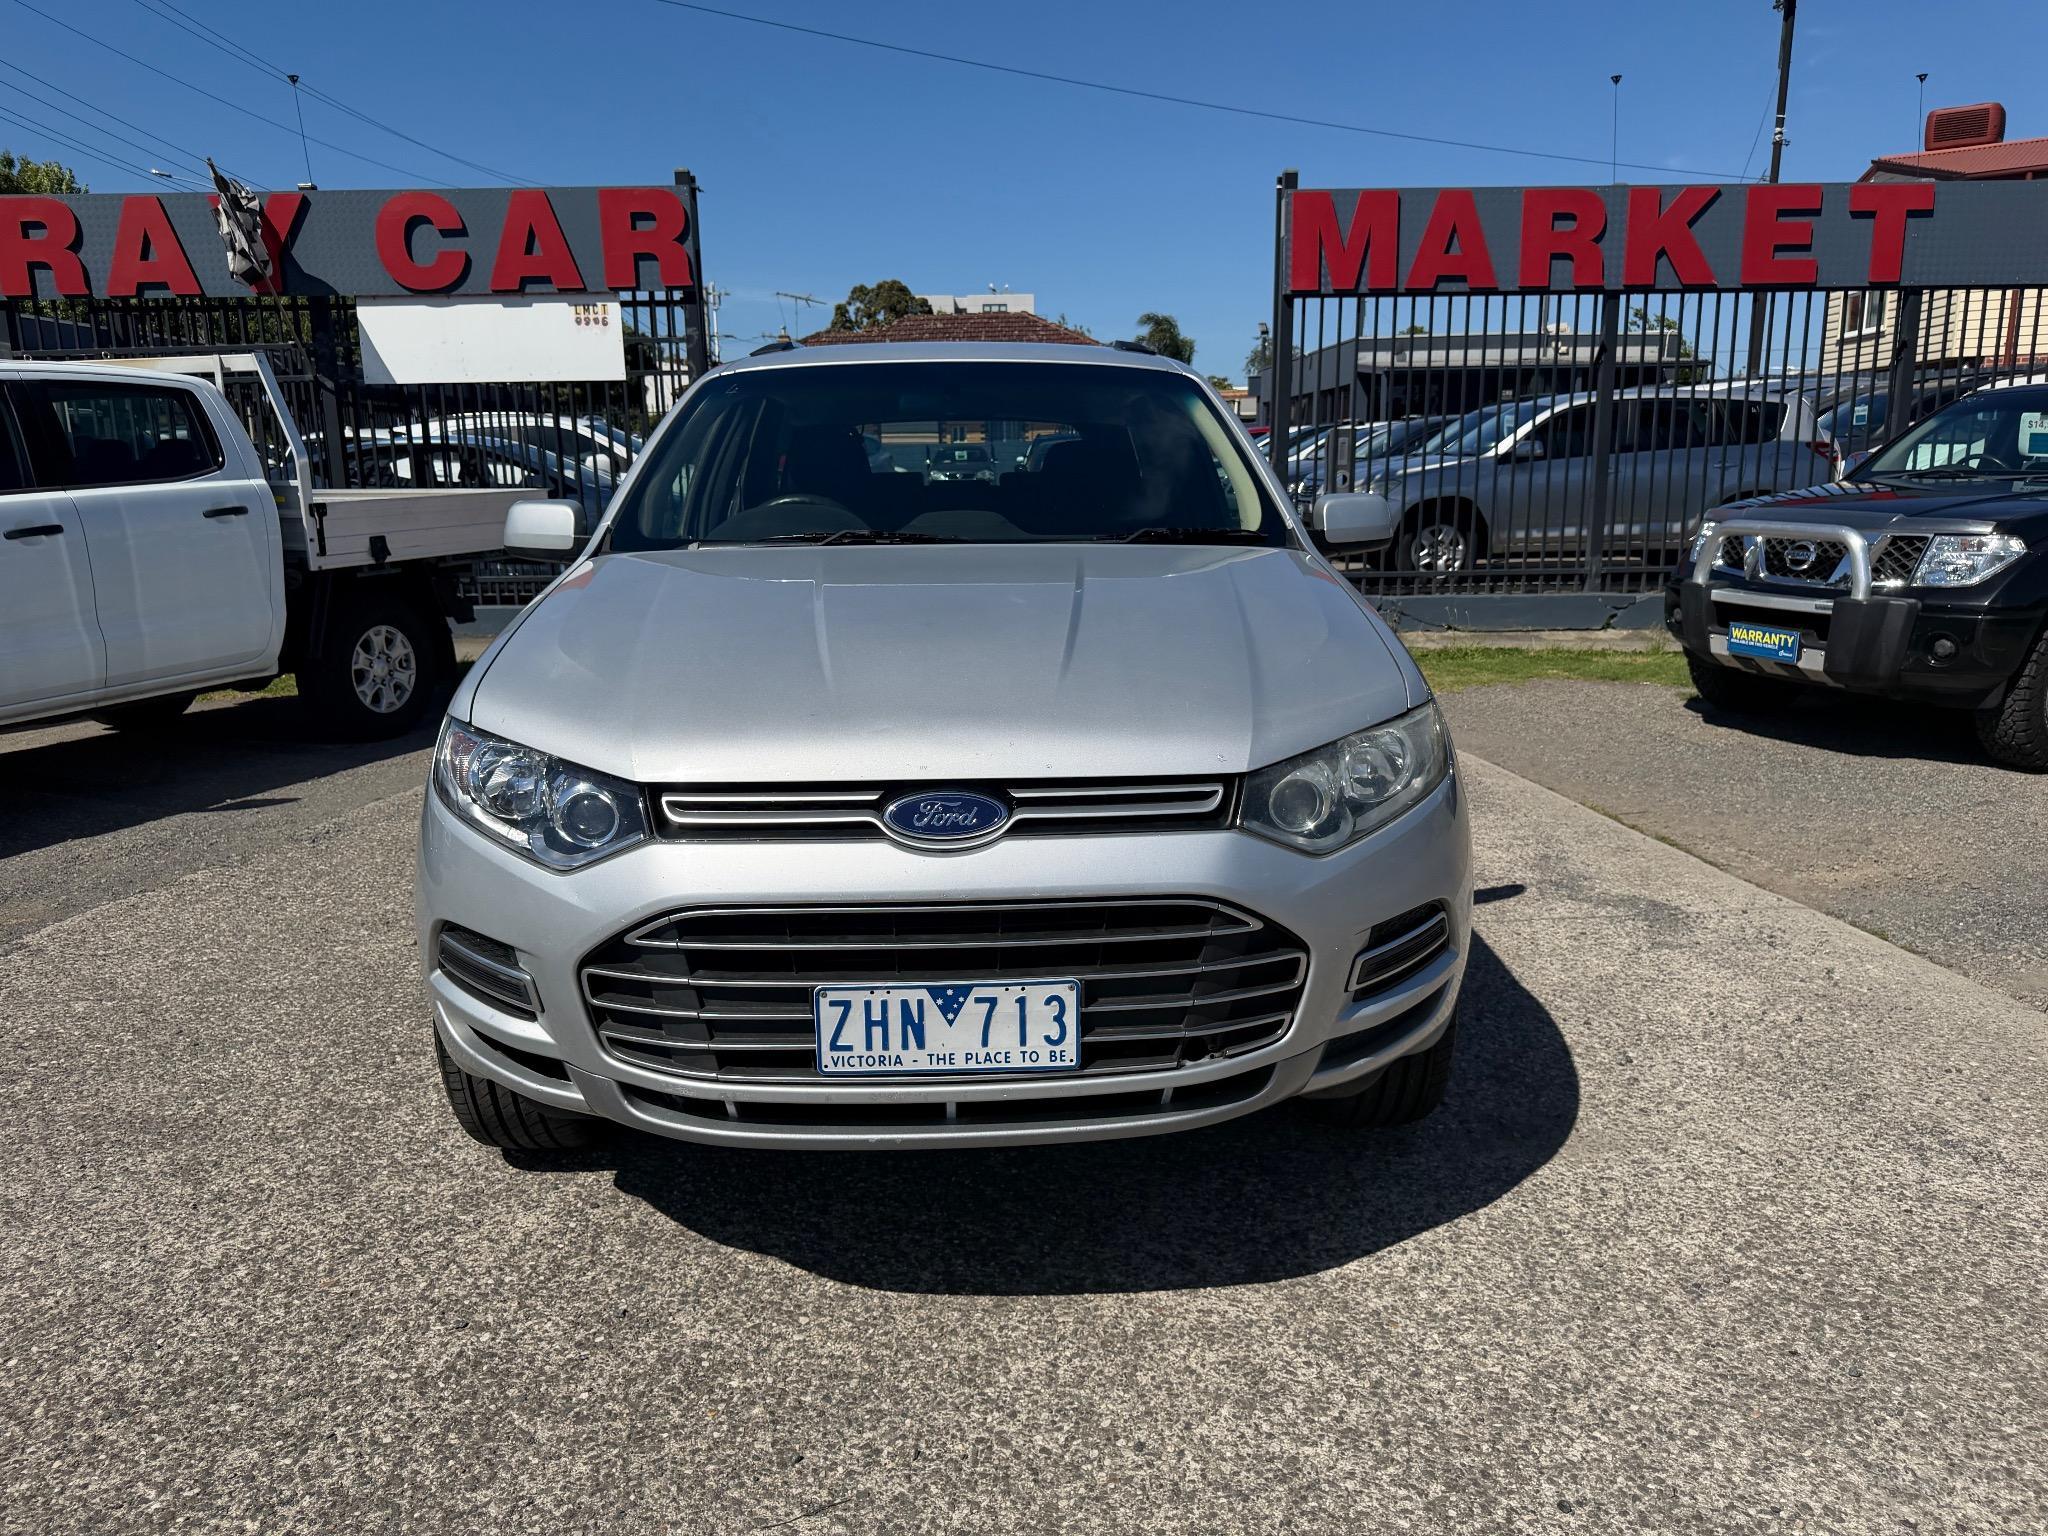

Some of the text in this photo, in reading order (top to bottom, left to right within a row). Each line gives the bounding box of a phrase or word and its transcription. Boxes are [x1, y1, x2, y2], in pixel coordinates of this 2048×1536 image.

[375, 188, 693, 292] CAR
[1290, 185, 1936, 292] MARKET
[574, 304, 608, 315] LMCT
[1732, 627, 1795, 648] WARRANTY
[913, 800, 978, 827] Ford
[828, 994, 1067, 1052] ZHN 713
[831, 1055, 904, 1068] VICTORIA
[927, 1053, 956, 1066] THE
[965, 1051, 1011, 1065] PLACE
[1021, 1050, 1040, 1063] TO
[1049, 1049, 1067, 1063] BE
